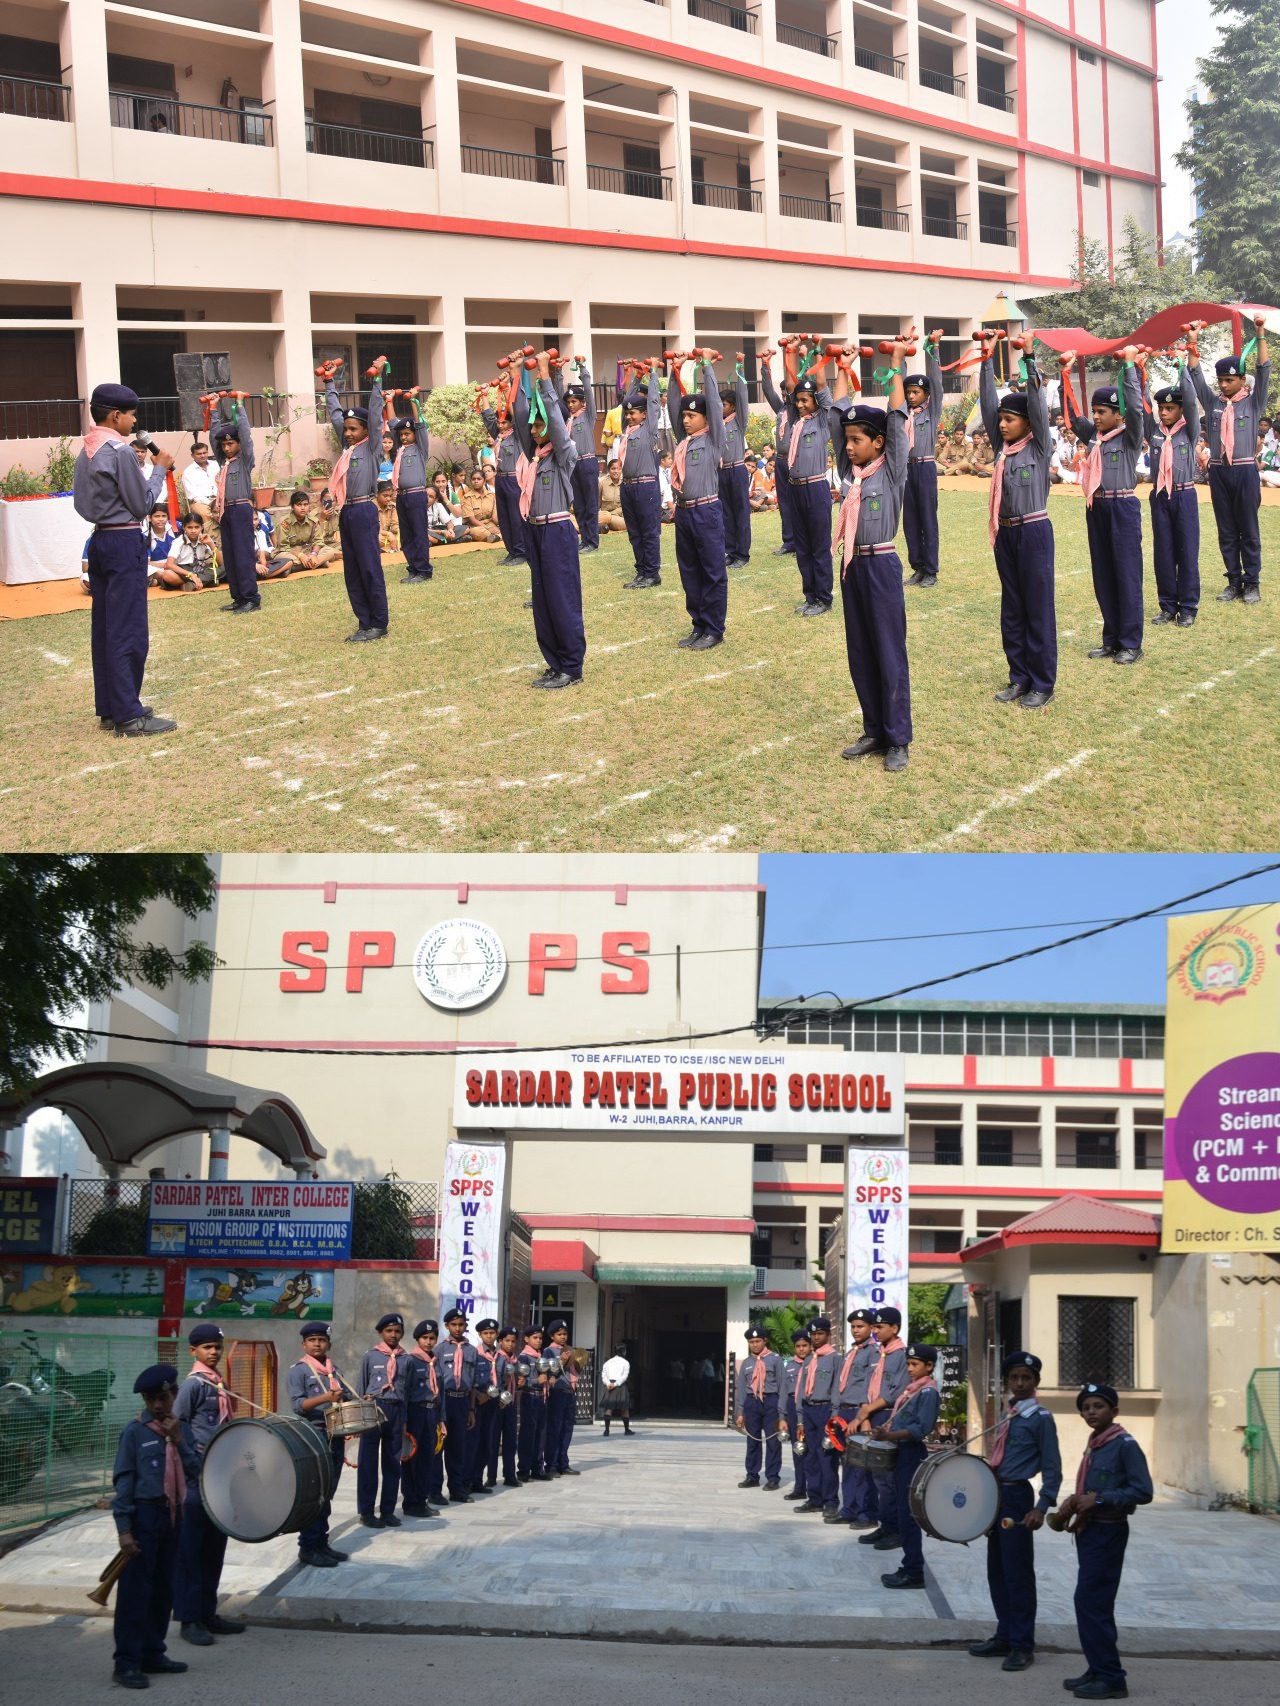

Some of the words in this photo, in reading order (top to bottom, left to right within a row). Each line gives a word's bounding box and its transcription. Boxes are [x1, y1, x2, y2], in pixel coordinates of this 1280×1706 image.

[571, 1054, 585, 1063] TO
[587, 1054, 600, 1063] BE
[602, 1055, 661, 1064] AFFILIATED
[663, 1055, 677, 1064] TO
[729, 1056, 752, 1065] NEW
[754, 1057, 785, 1065] DELHI
[466, 1069, 572, 1107] SARDAR
[583, 1071, 668, 1109] PATEL
[679, 1073, 777, 1111] PUBLIC
[788, 1073, 892, 1112] SCHOOL
[609, 1115, 627, 1124] W-2
[700, 1116, 743, 1125] KANPUR
[1192, 1138, 1244, 1162] (PCM
[1195, 1165, 1211, 1183] &
[1216, 1164, 1280, 1183] Comm
[154, 1185, 201, 1206] SARDAR
[205, 1185, 244, 1206] PATEL
[251, 1186, 289, 1207] INTER
[293, 1186, 349, 1208] COLLEGE
[450, 1179, 494, 1197] SPPS
[856, 1186, 903, 1204] SPPS
[0, 1191, 39, 1213] EL
[207, 1208, 226, 1217] JUHI
[228, 1208, 255, 1217] BARRA
[258, 1209, 291, 1218] KANPUR
[189, 1222, 222, 1237] VISION
[225, 1222, 258, 1237] GROUP
[262, 1223, 276, 1238] OF
[278, 1223, 347, 1239] INSTITUTIONS
[1175, 1229, 1231, 1242] Director
[1244, 1227, 1268, 1241] Ch.
[218, 1239, 264, 1248] POLYTECHNIC
[456, 1202, 480, 1332] WELCOM
